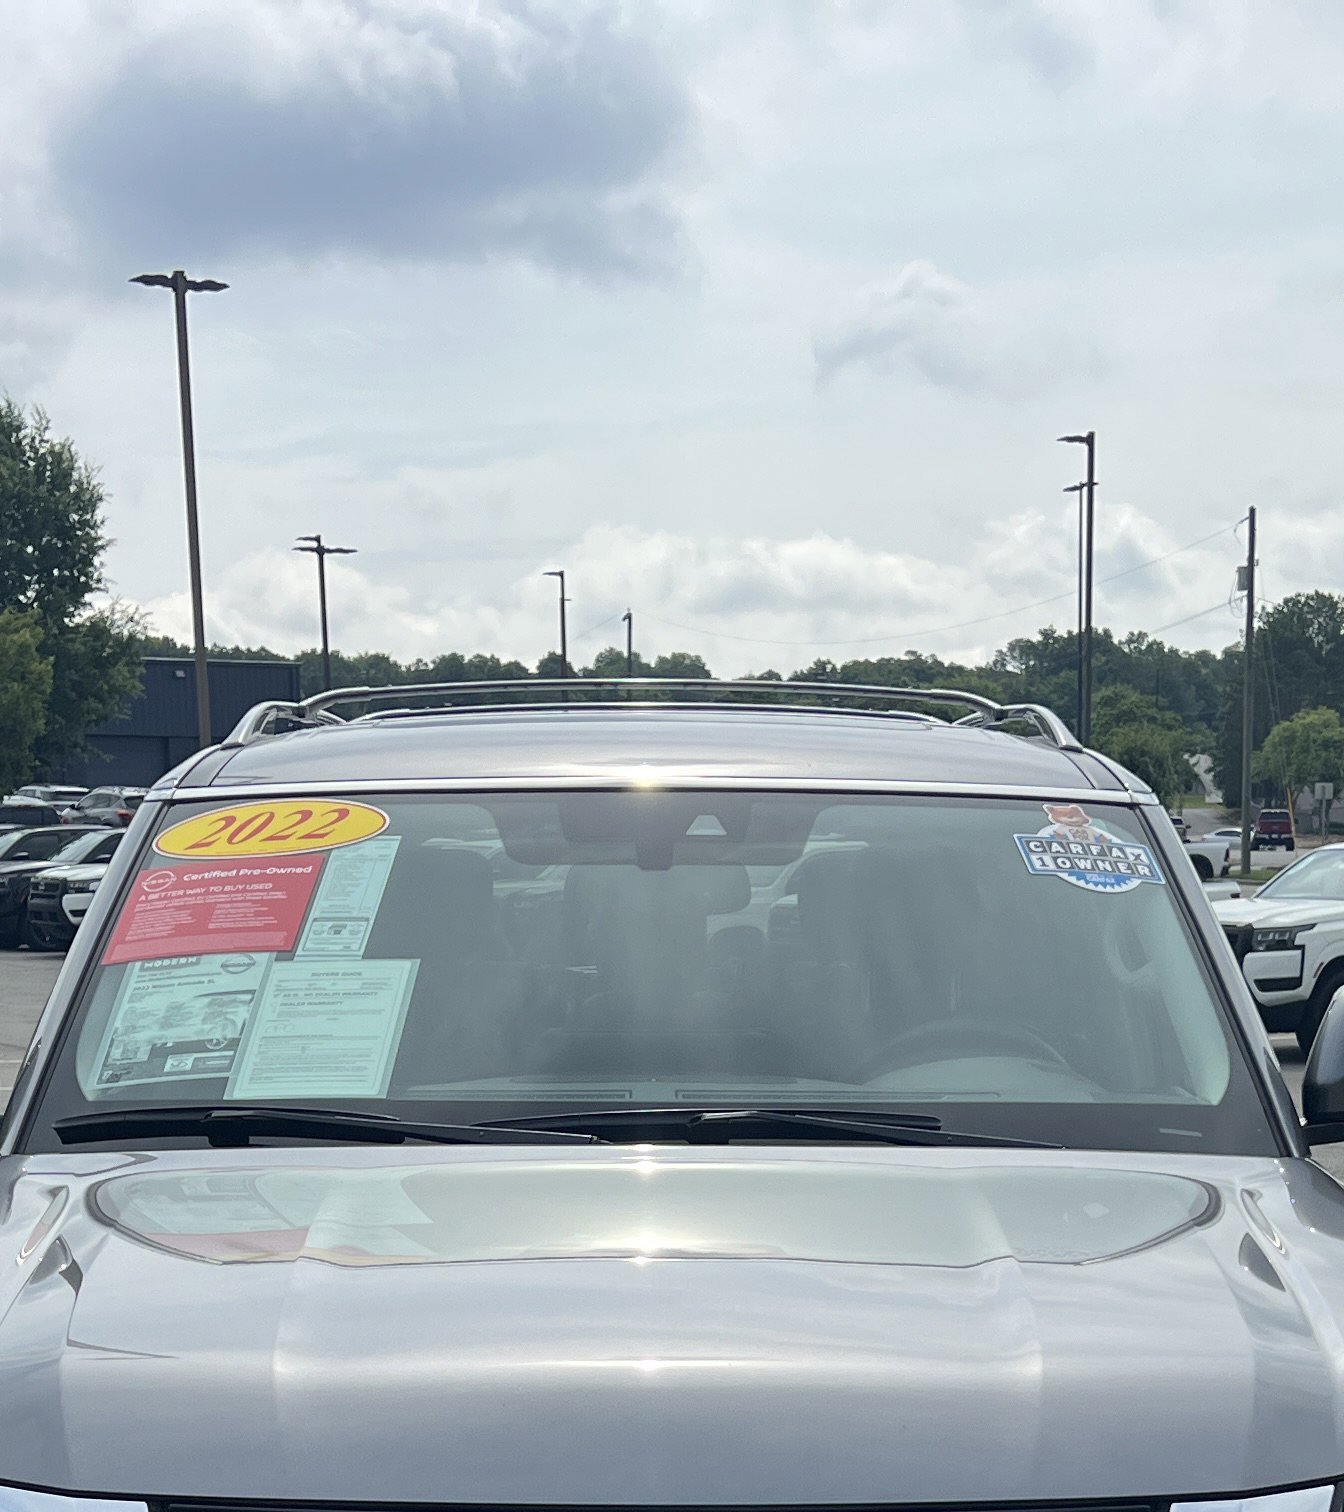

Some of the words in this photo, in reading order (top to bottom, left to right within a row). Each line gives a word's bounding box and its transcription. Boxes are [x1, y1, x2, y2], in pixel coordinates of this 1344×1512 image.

[184, 808, 350, 850] 2022
[1028, 841, 1149, 864] CARFAX
[183, 870, 238, 881] Certified
[239, 866, 313, 877] Pre-Owned
[1036, 856, 1050, 868] 1
[1056, 857, 1152, 877] OWNER
[147, 890, 184, 901] BETTER
[186, 887, 207, 896] WAY
[223, 884, 245, 892] BUY
[246, 882, 273, 890] USED
